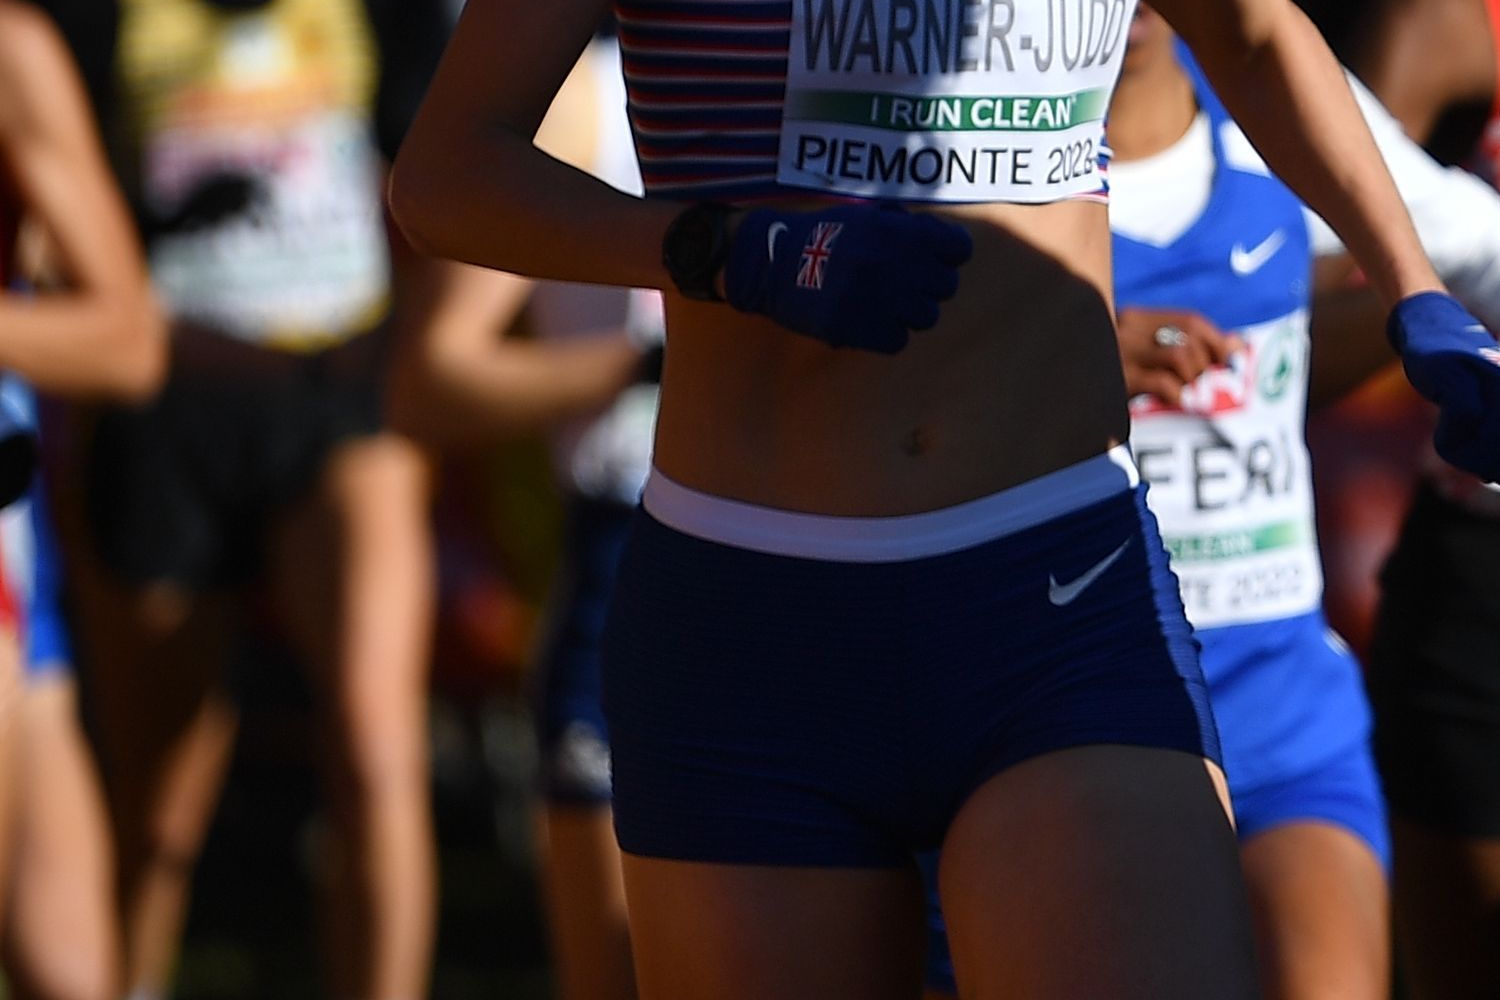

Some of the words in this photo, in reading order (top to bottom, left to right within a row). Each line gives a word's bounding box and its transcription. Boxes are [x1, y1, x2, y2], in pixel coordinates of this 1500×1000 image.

[870, 97, 879, 122] I
[890, 96, 963, 128] RUN
[796, 134, 1033, 186] PIEMONTE
